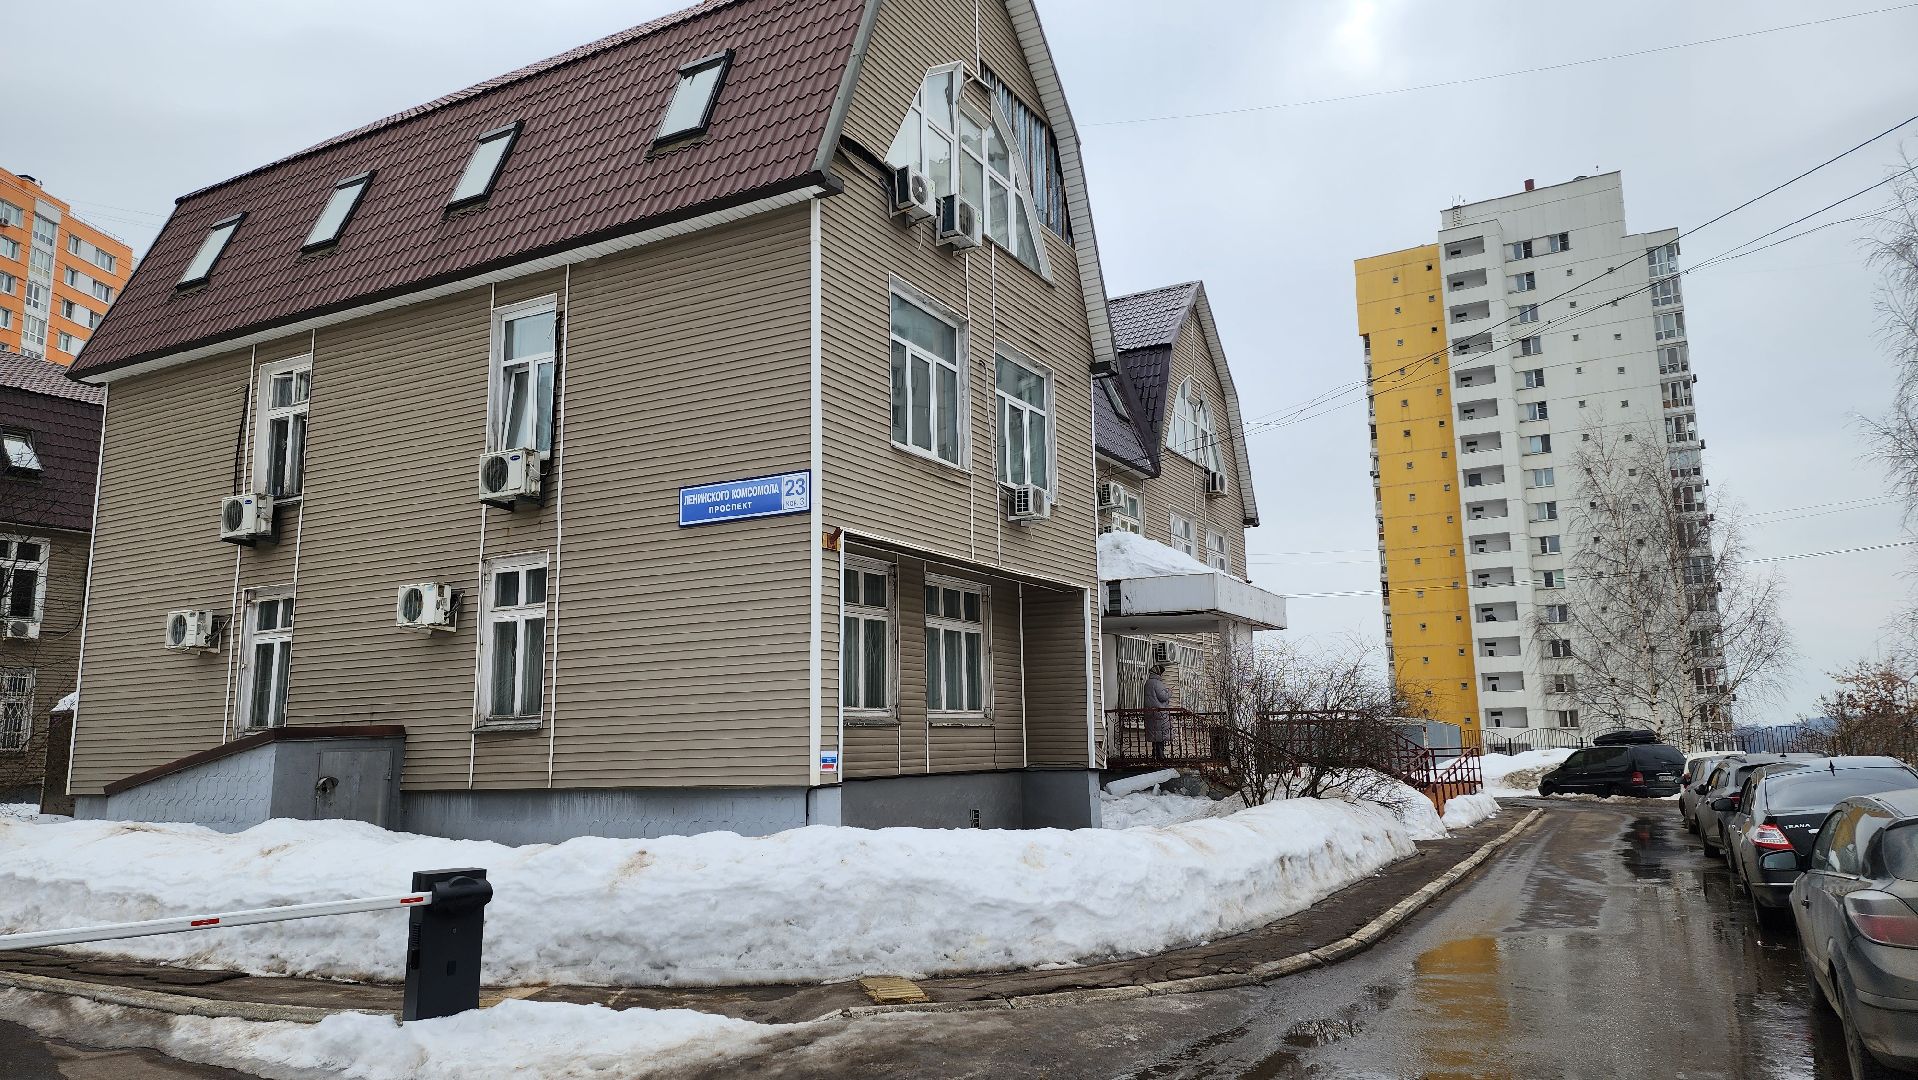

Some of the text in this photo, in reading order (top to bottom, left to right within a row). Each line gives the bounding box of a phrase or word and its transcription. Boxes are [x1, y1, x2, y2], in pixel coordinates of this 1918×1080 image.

[684, 483, 780, 505] ЛЕНИНСКОГО КОМСОМОЛА
[785, 478, 806, 496] 23
[708, 502, 753, 514] ПРОСПЕКТ
[799, 497, 805, 506] 3
